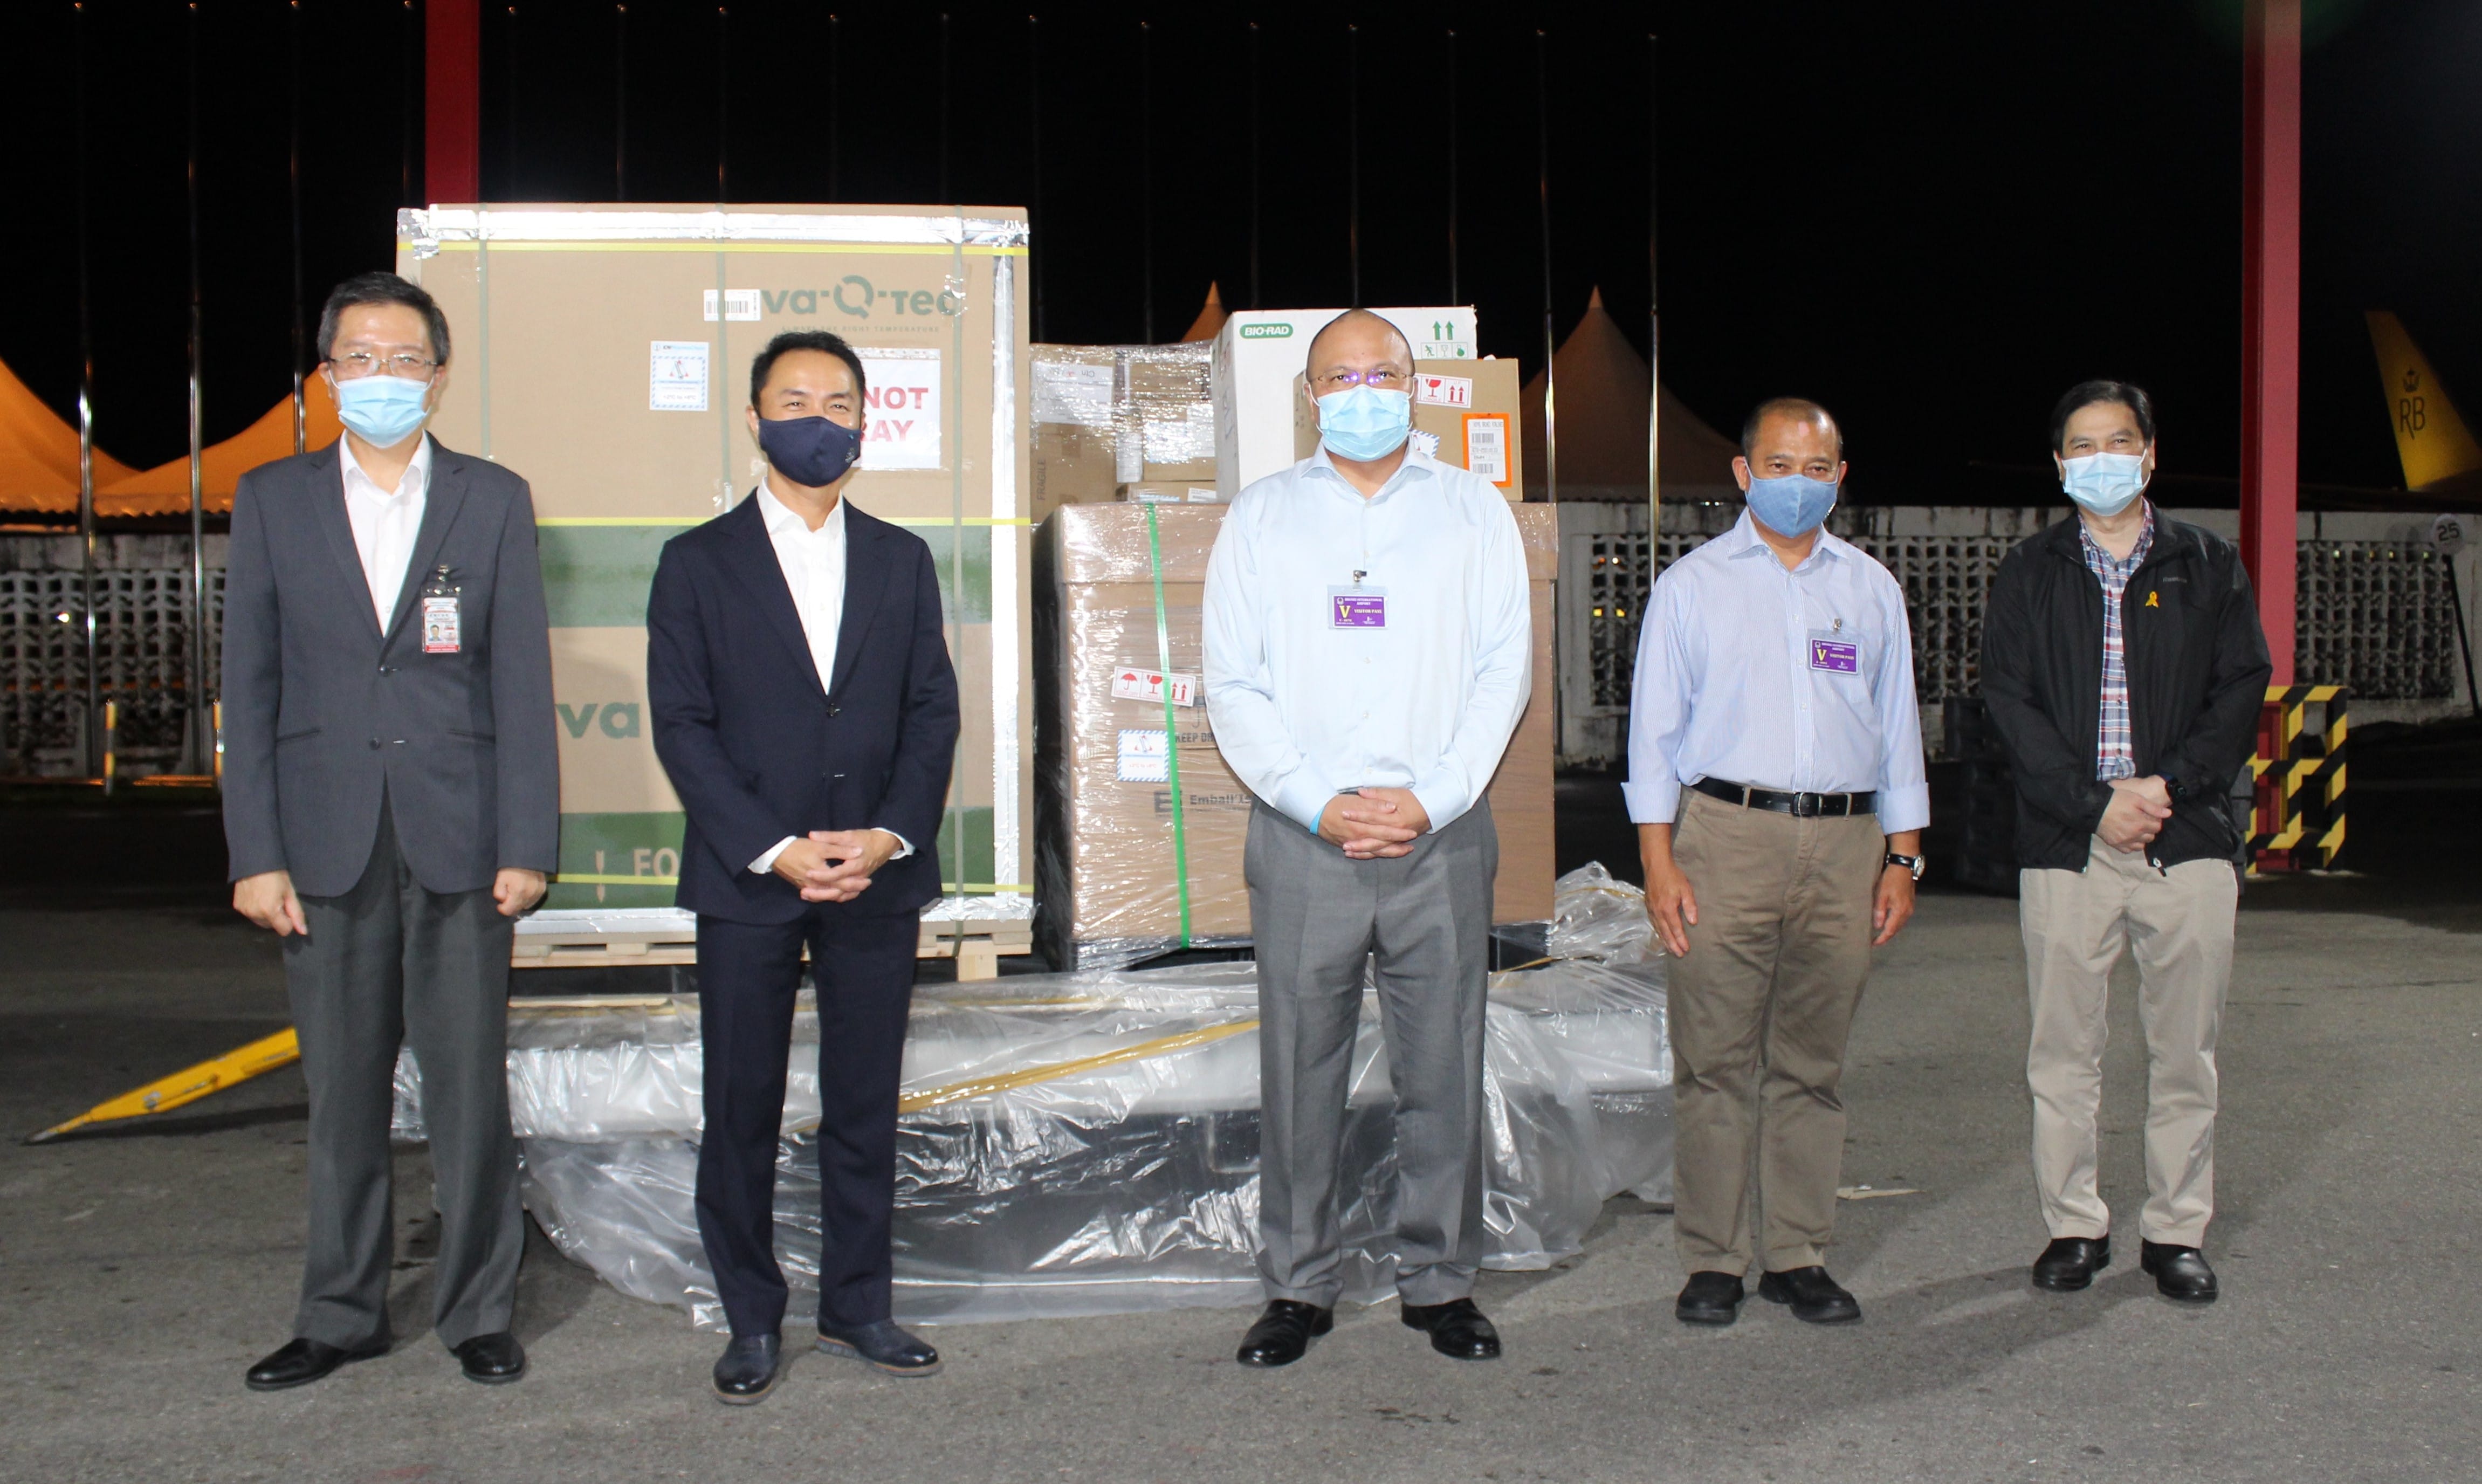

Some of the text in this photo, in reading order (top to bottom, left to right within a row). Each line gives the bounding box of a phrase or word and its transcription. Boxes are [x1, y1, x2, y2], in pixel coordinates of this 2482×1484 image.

[1245, 326, 1289, 336] BIO-RAD
[864, 387, 929, 409] NOT
[2400, 396, 2426, 440] RB
[861, 420, 914, 442] AY
[1036, 459, 1046, 501] FRAGILE
[2437, 523, 2460, 541] 25
[1339, 605, 1351, 618] V
[1817, 649, 1827, 661] V
[1175, 733, 1198, 743] KEEP
